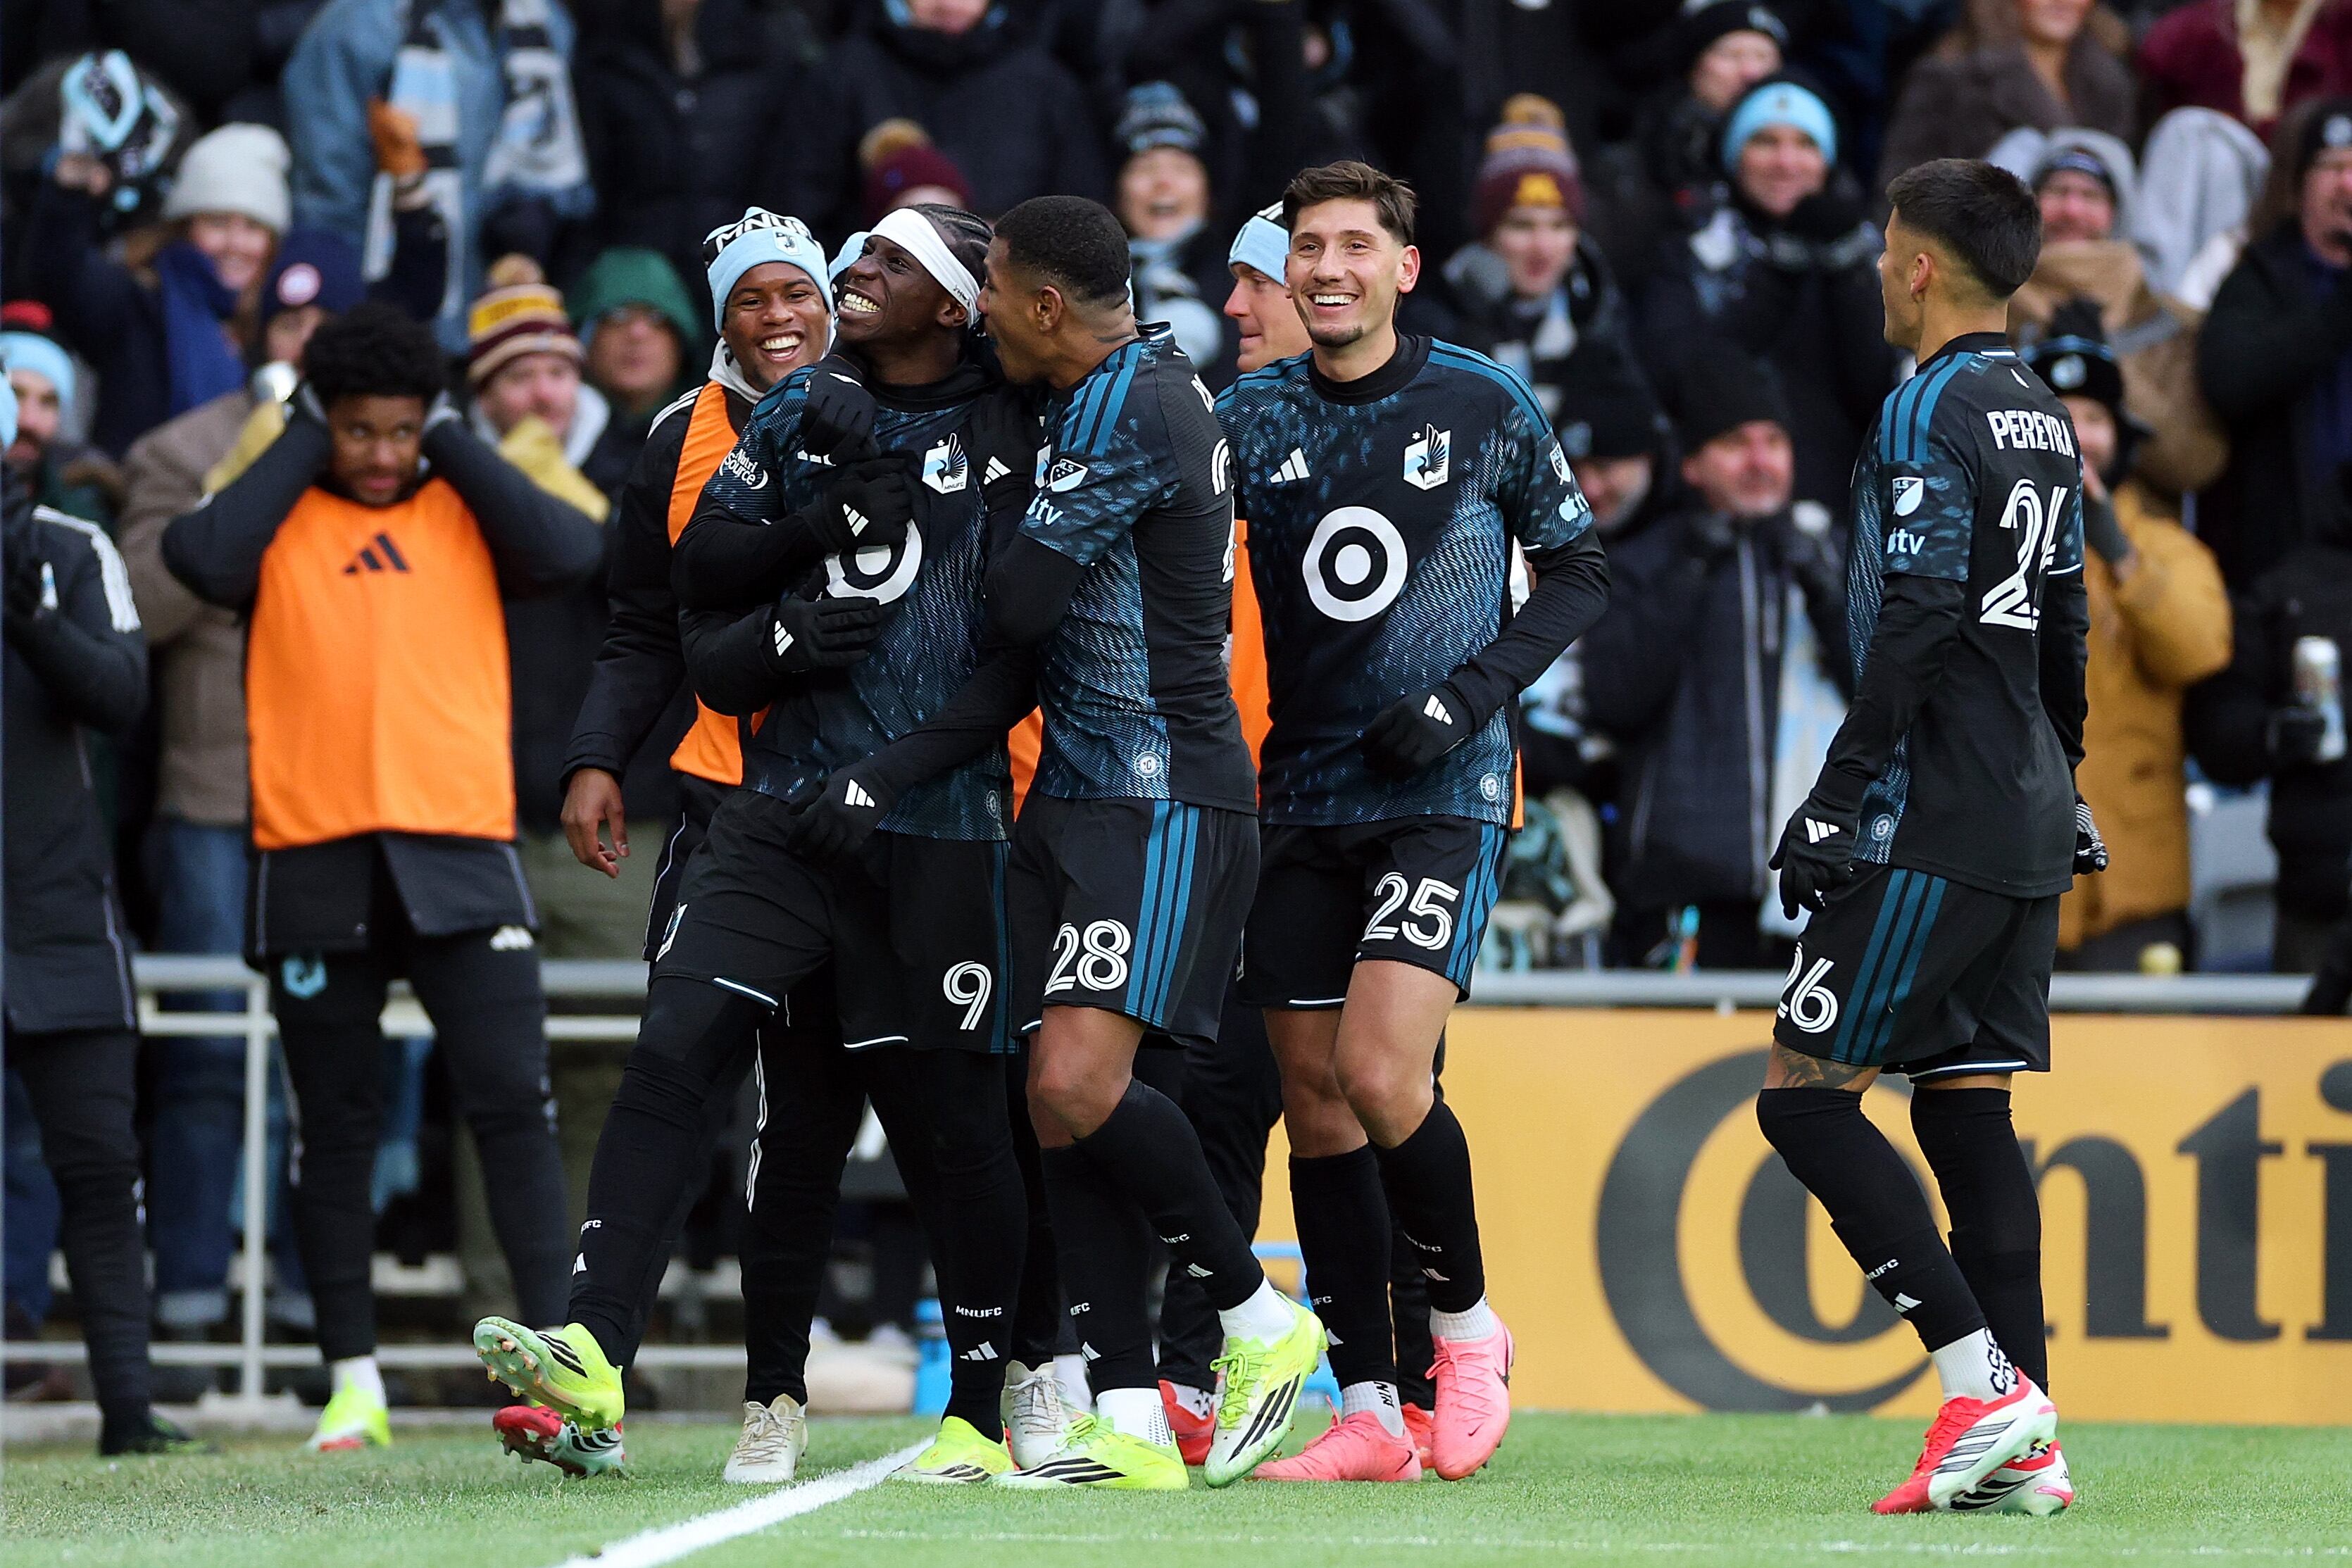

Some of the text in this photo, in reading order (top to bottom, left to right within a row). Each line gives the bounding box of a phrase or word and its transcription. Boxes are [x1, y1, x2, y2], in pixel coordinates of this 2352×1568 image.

[1986, 410, 2075, 458] PEREYRA
[724, 452, 756, 486] Source
[735, 448, 758, 473] Nutri
[1896, 528, 1926, 555] tv
[1361, 872, 1460, 951] 25
[1044, 918, 1132, 996] 28
[943, 960, 992, 1031] 9
[956, 1305, 1002, 1317] MNUFC
